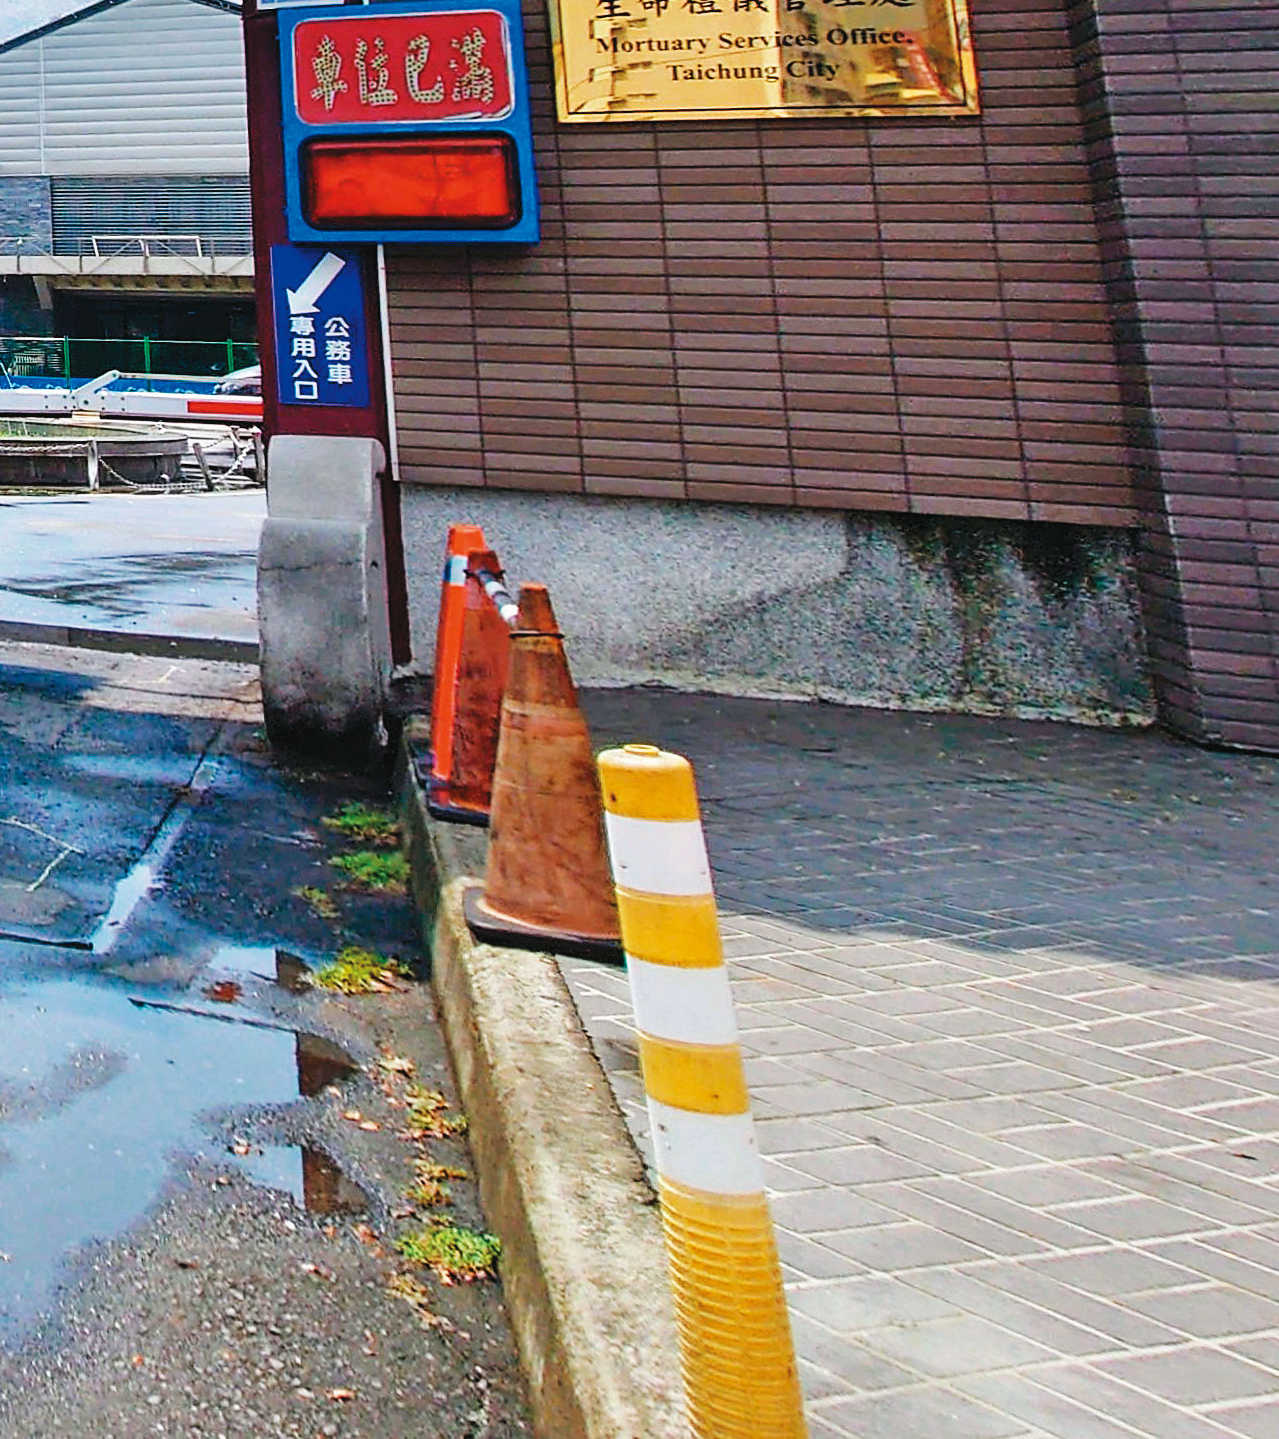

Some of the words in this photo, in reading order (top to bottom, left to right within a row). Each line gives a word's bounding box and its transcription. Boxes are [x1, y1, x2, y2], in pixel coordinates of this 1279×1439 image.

[311, 26, 494, 112] 車位已滿
[595, 35, 711, 55] Mortuary
[718, 31, 819, 50] Services
[666, 64, 781, 84] Taichung
[794, 59, 841, 82] City
[289, 316, 319, 400] 專用入口
[323, 316, 354, 385] 公務車
